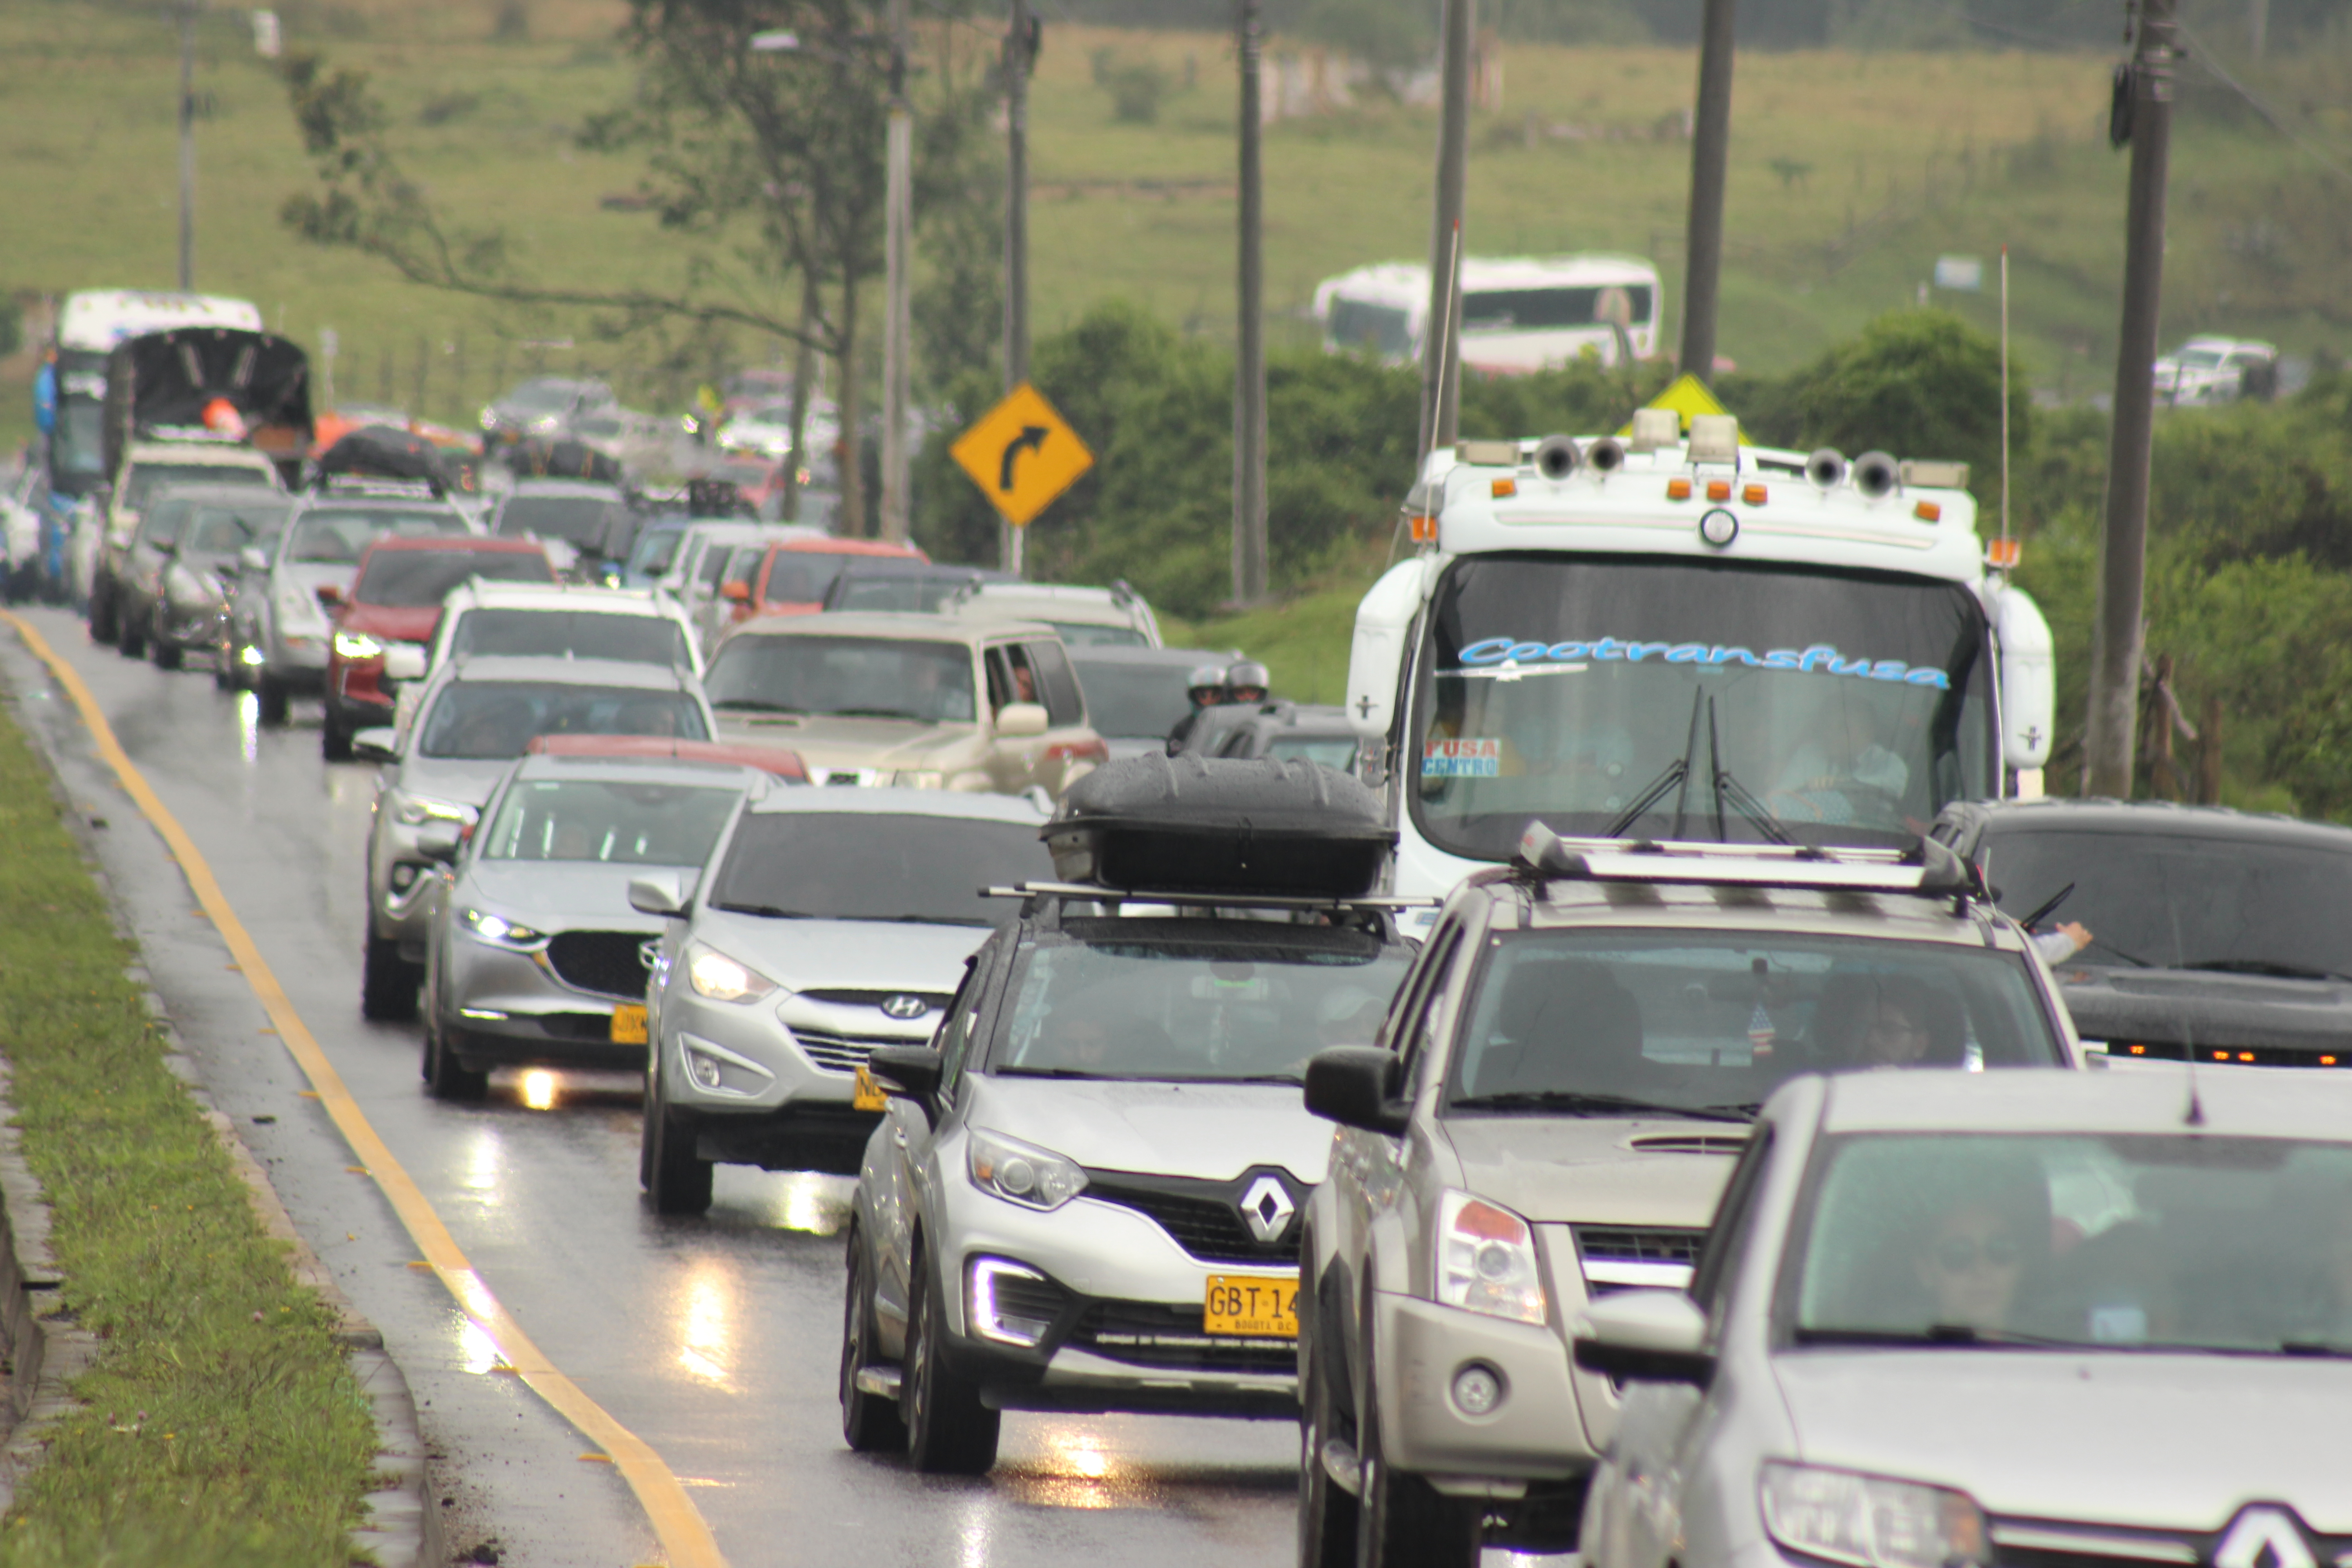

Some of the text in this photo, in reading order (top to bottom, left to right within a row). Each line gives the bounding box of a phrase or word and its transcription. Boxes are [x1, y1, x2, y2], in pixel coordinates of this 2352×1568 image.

[1458, 637, 1951, 690] Cootransfusa
[1424, 739, 1497, 758] FUSA
[1421, 758, 1498, 775] CENTRO
